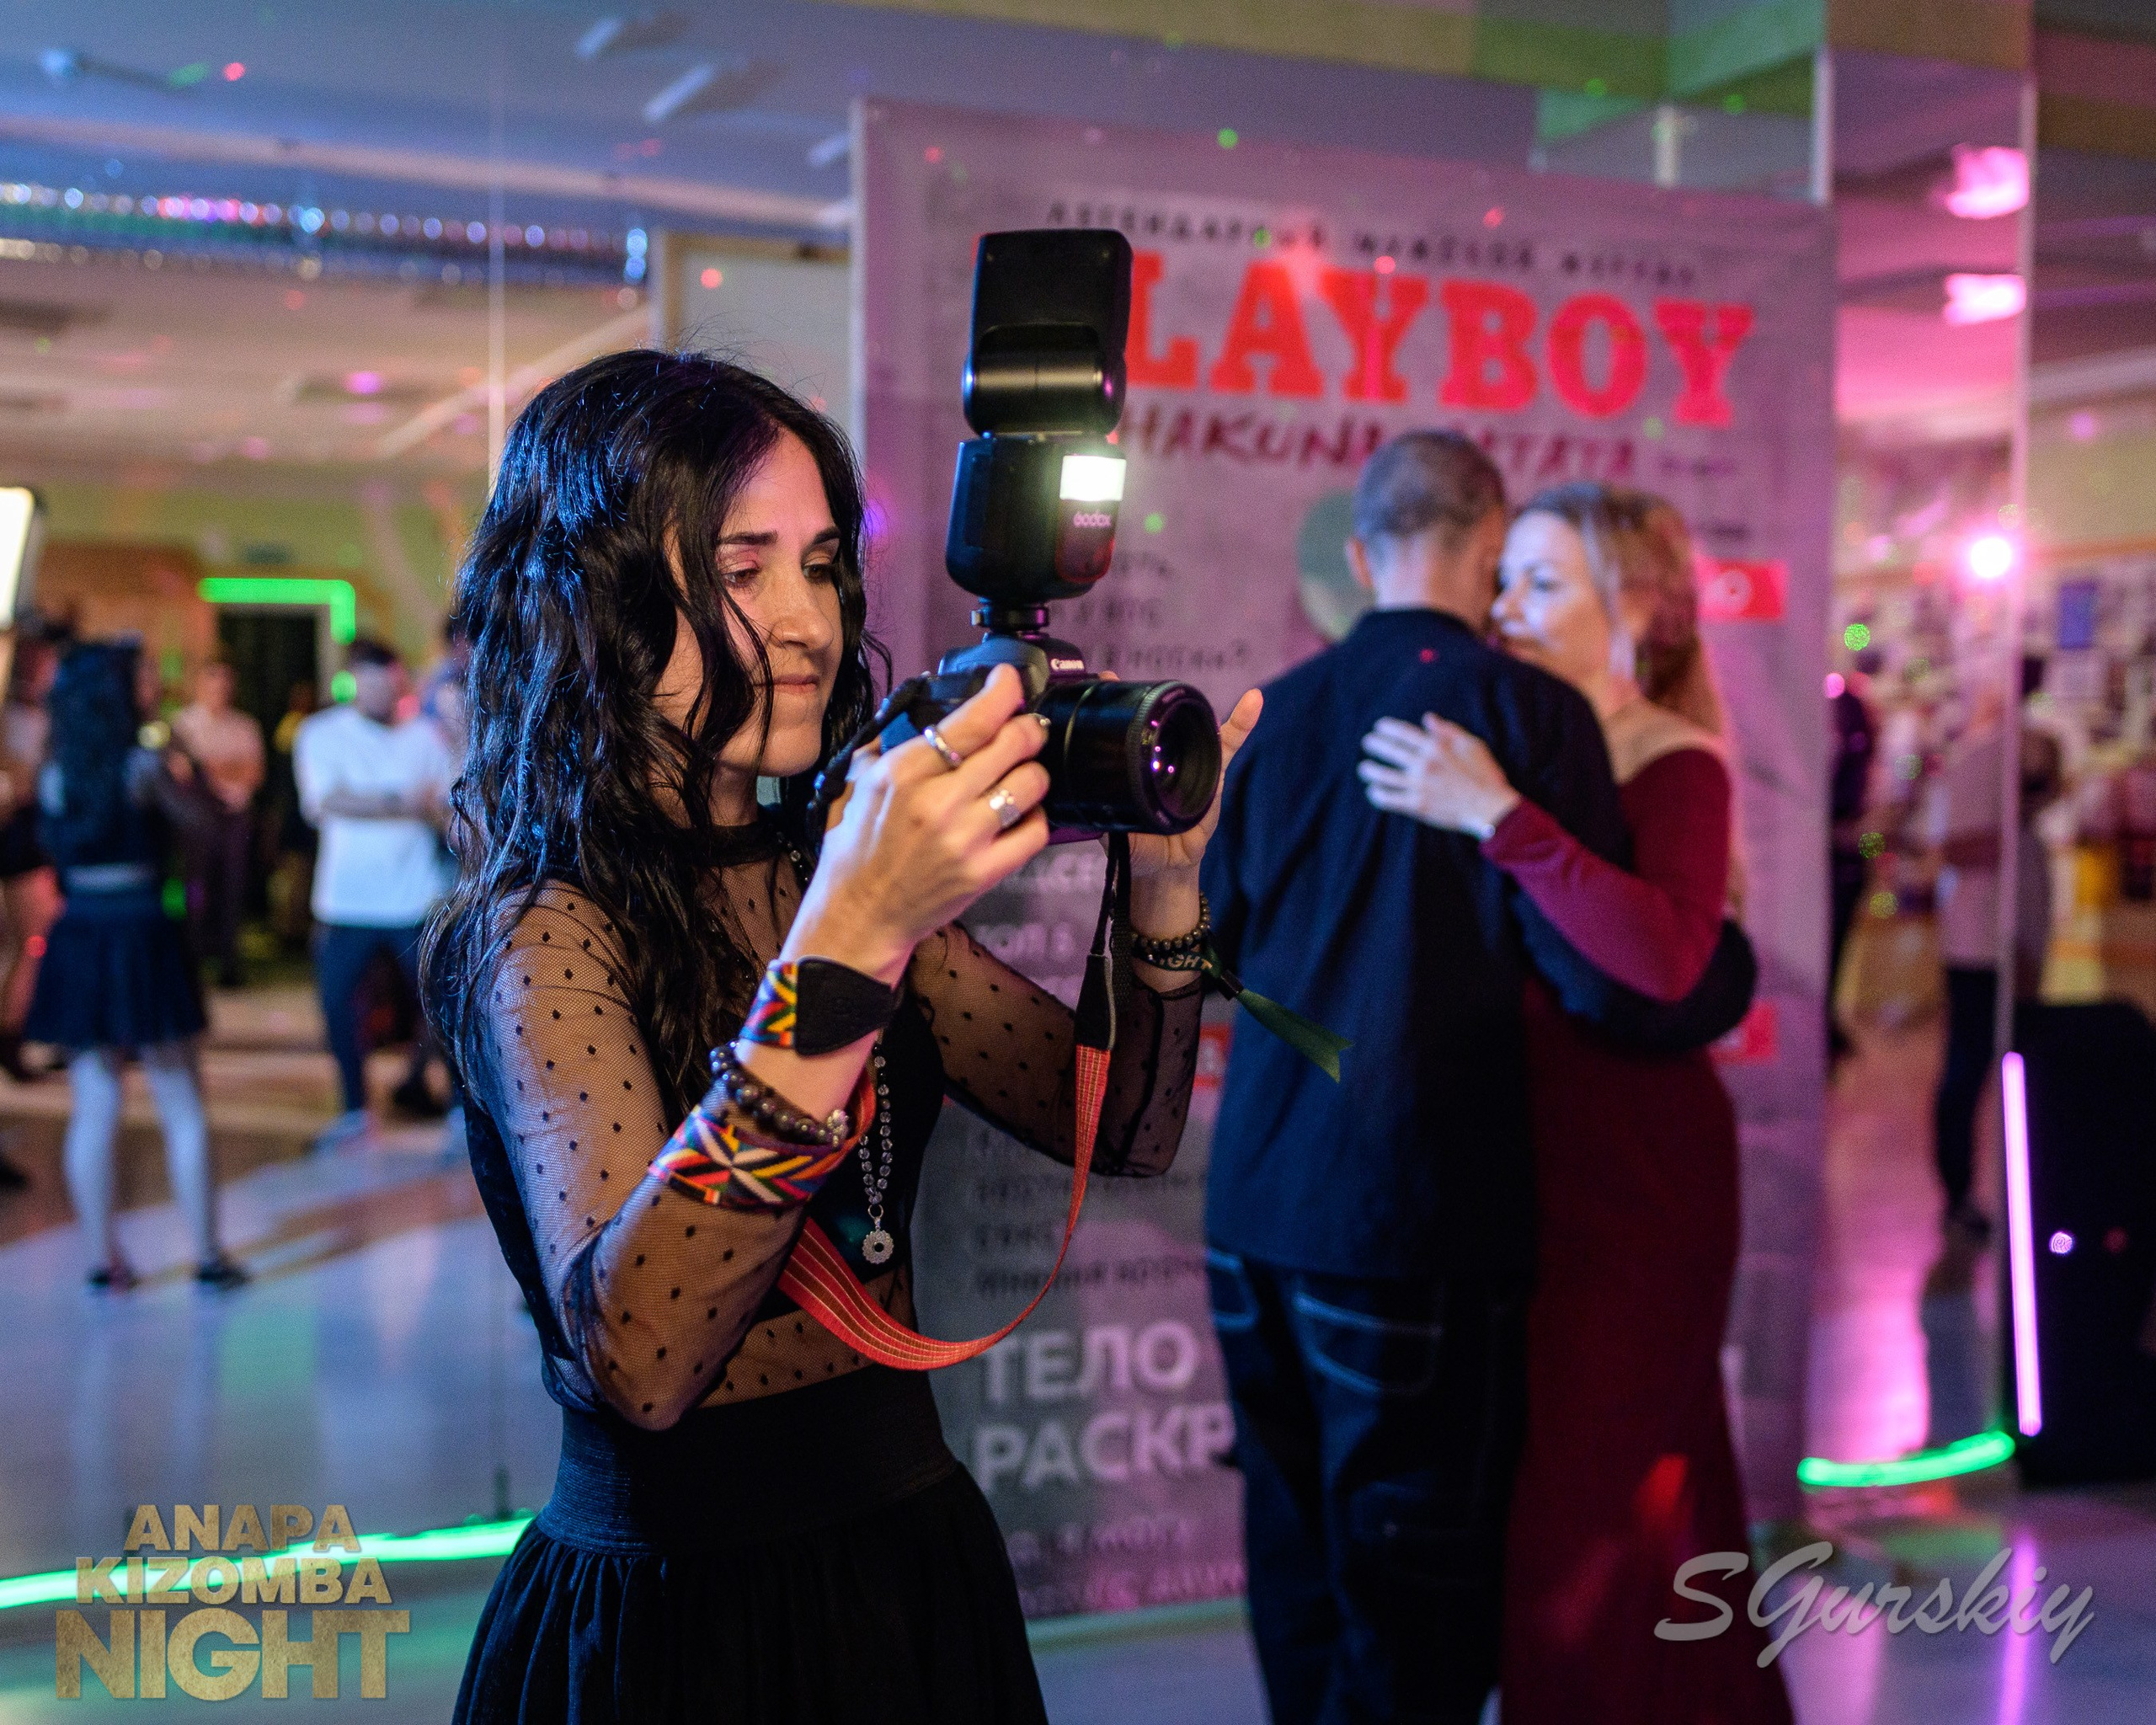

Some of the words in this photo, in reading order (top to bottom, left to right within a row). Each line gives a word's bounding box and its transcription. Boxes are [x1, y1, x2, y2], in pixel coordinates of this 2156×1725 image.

[1124, 249, 1755, 430] LAYBOY
[1050, 658, 1085, 670] Canon
[1157, 953, 1213, 970] IGHT
[987, 1319, 1198, 1405] ТЕЛО
